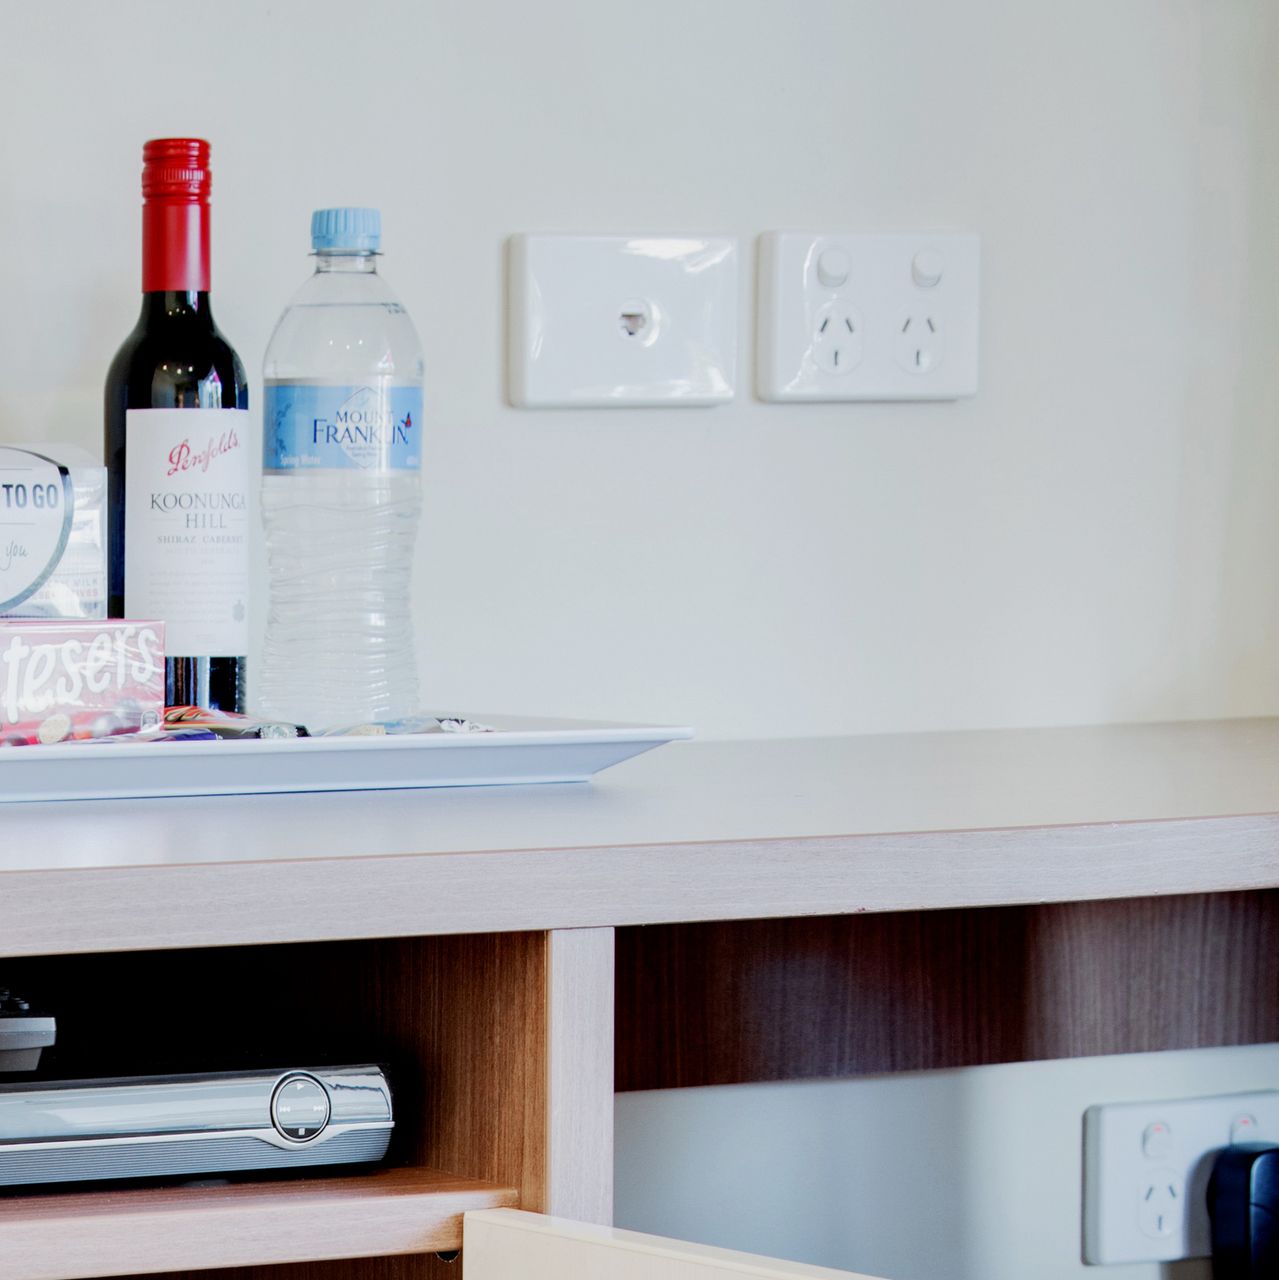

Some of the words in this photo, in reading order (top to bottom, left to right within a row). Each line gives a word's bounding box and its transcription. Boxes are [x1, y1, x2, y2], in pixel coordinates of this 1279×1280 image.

[3, 483, 27, 508] TO
[32, 484, 59, 508] GO
[185, 513, 227, 529] HILL
[5, 541, 28, 571] you
